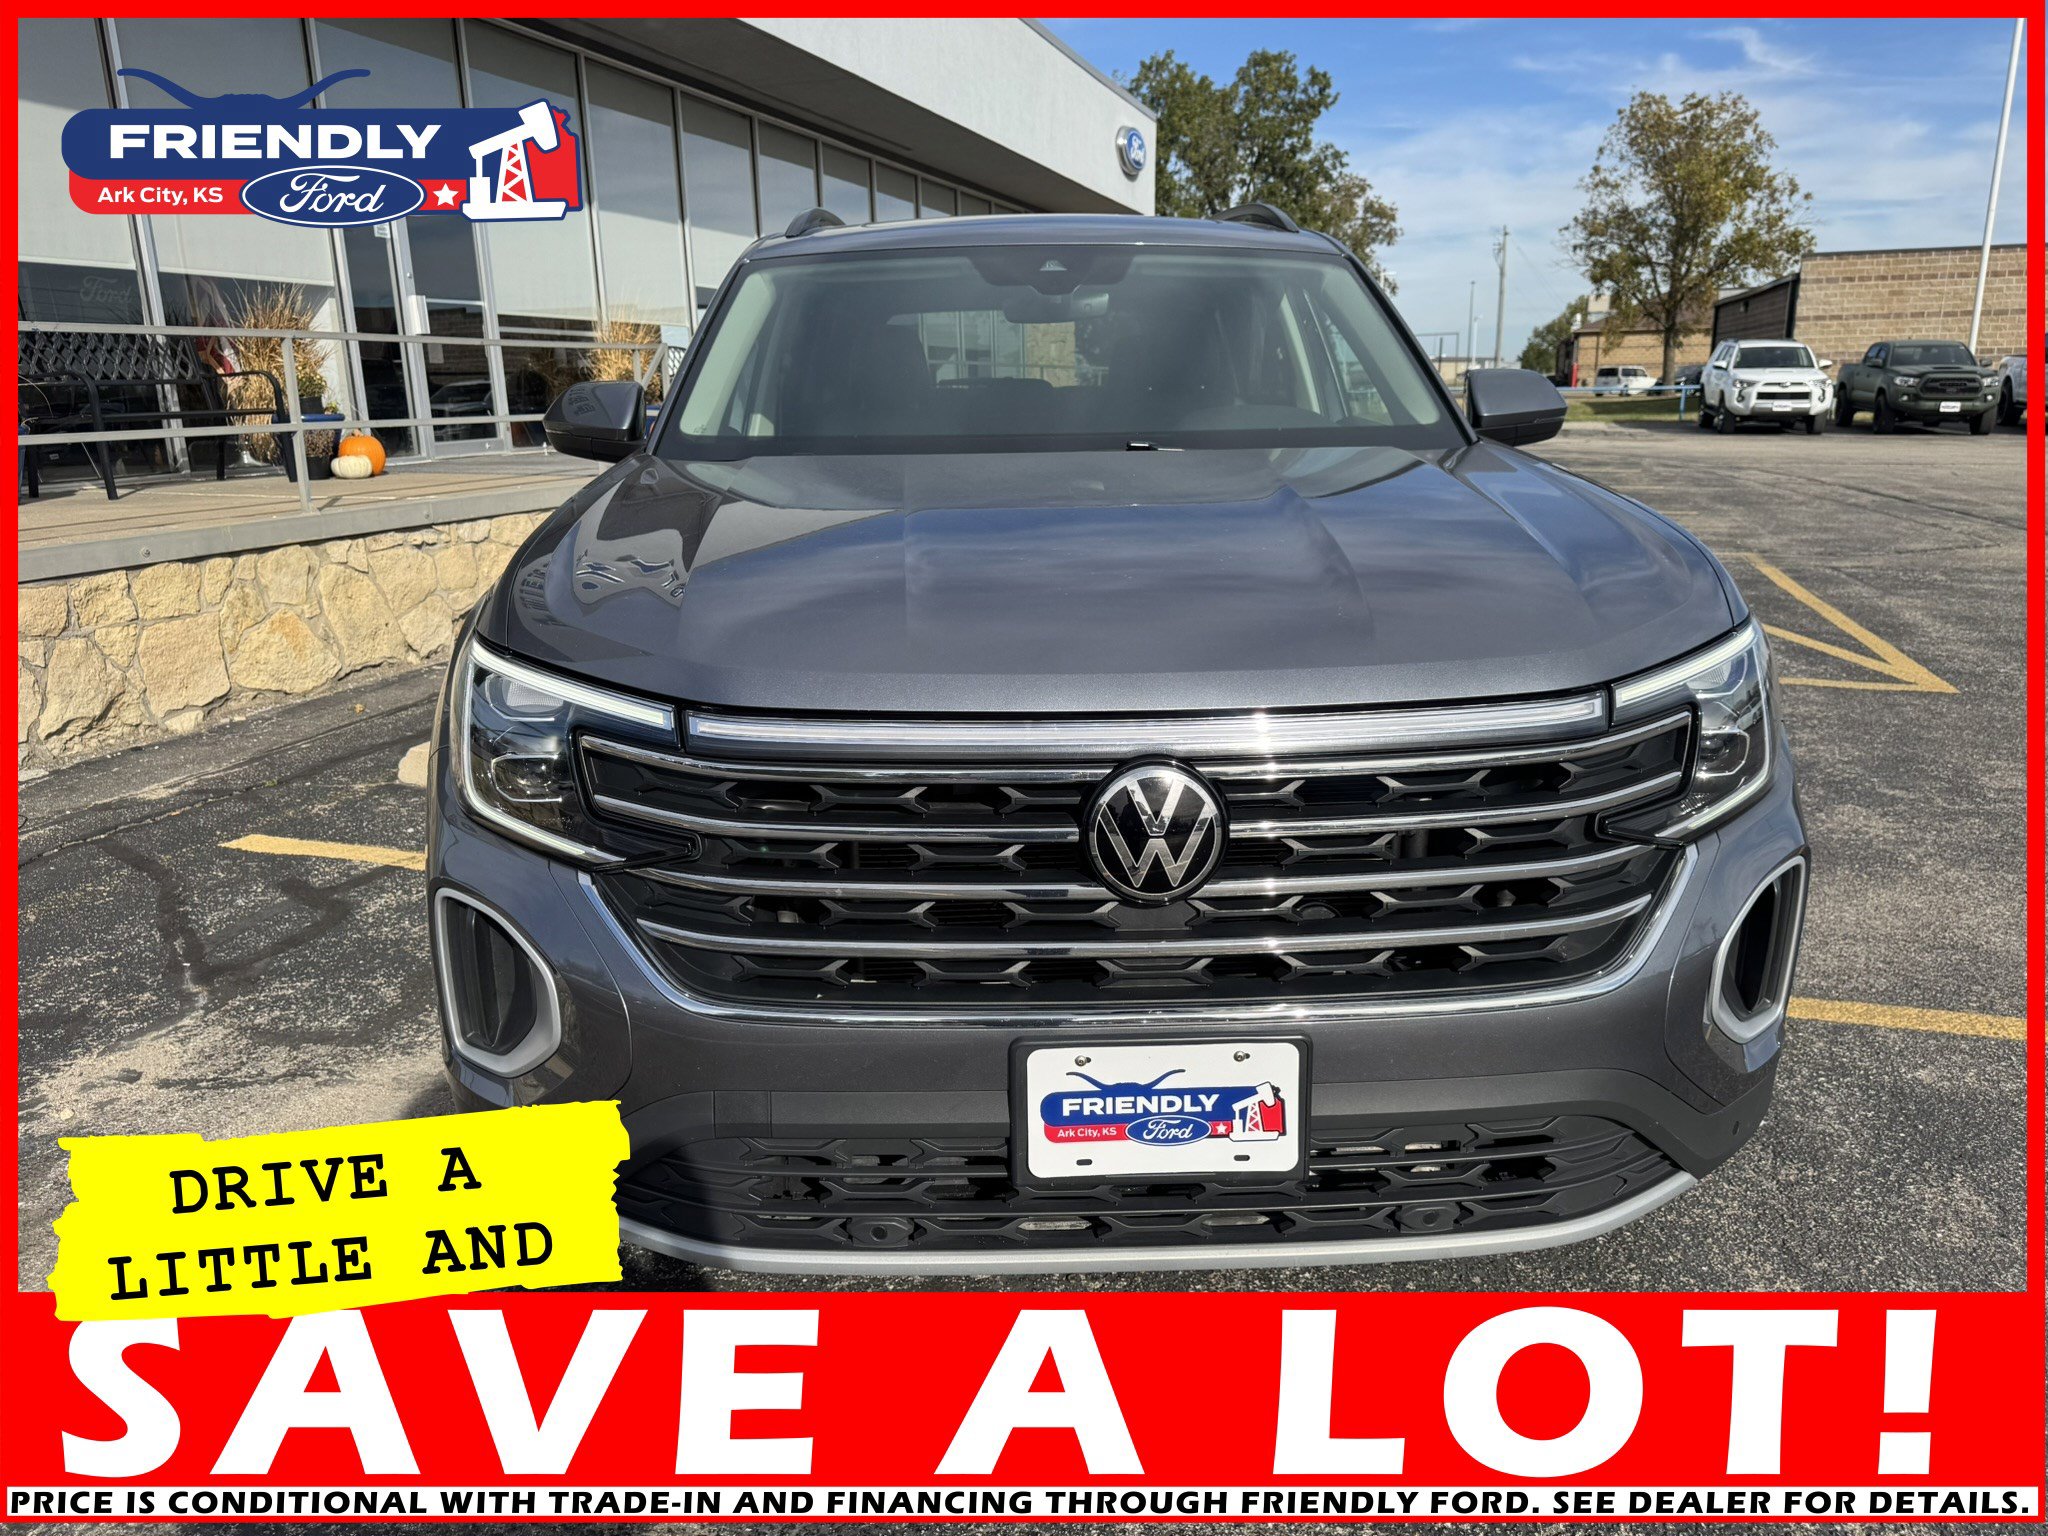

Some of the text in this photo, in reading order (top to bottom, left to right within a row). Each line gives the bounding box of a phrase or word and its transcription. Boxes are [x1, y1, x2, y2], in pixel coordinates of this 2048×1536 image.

[1099, 775, 1213, 888] VW
[1062, 1093, 1220, 1117] FRIENDLY
[1057, 1126, 1117, 1138] Ark City, KS
[1143, 1119, 1193, 1141] Ford
